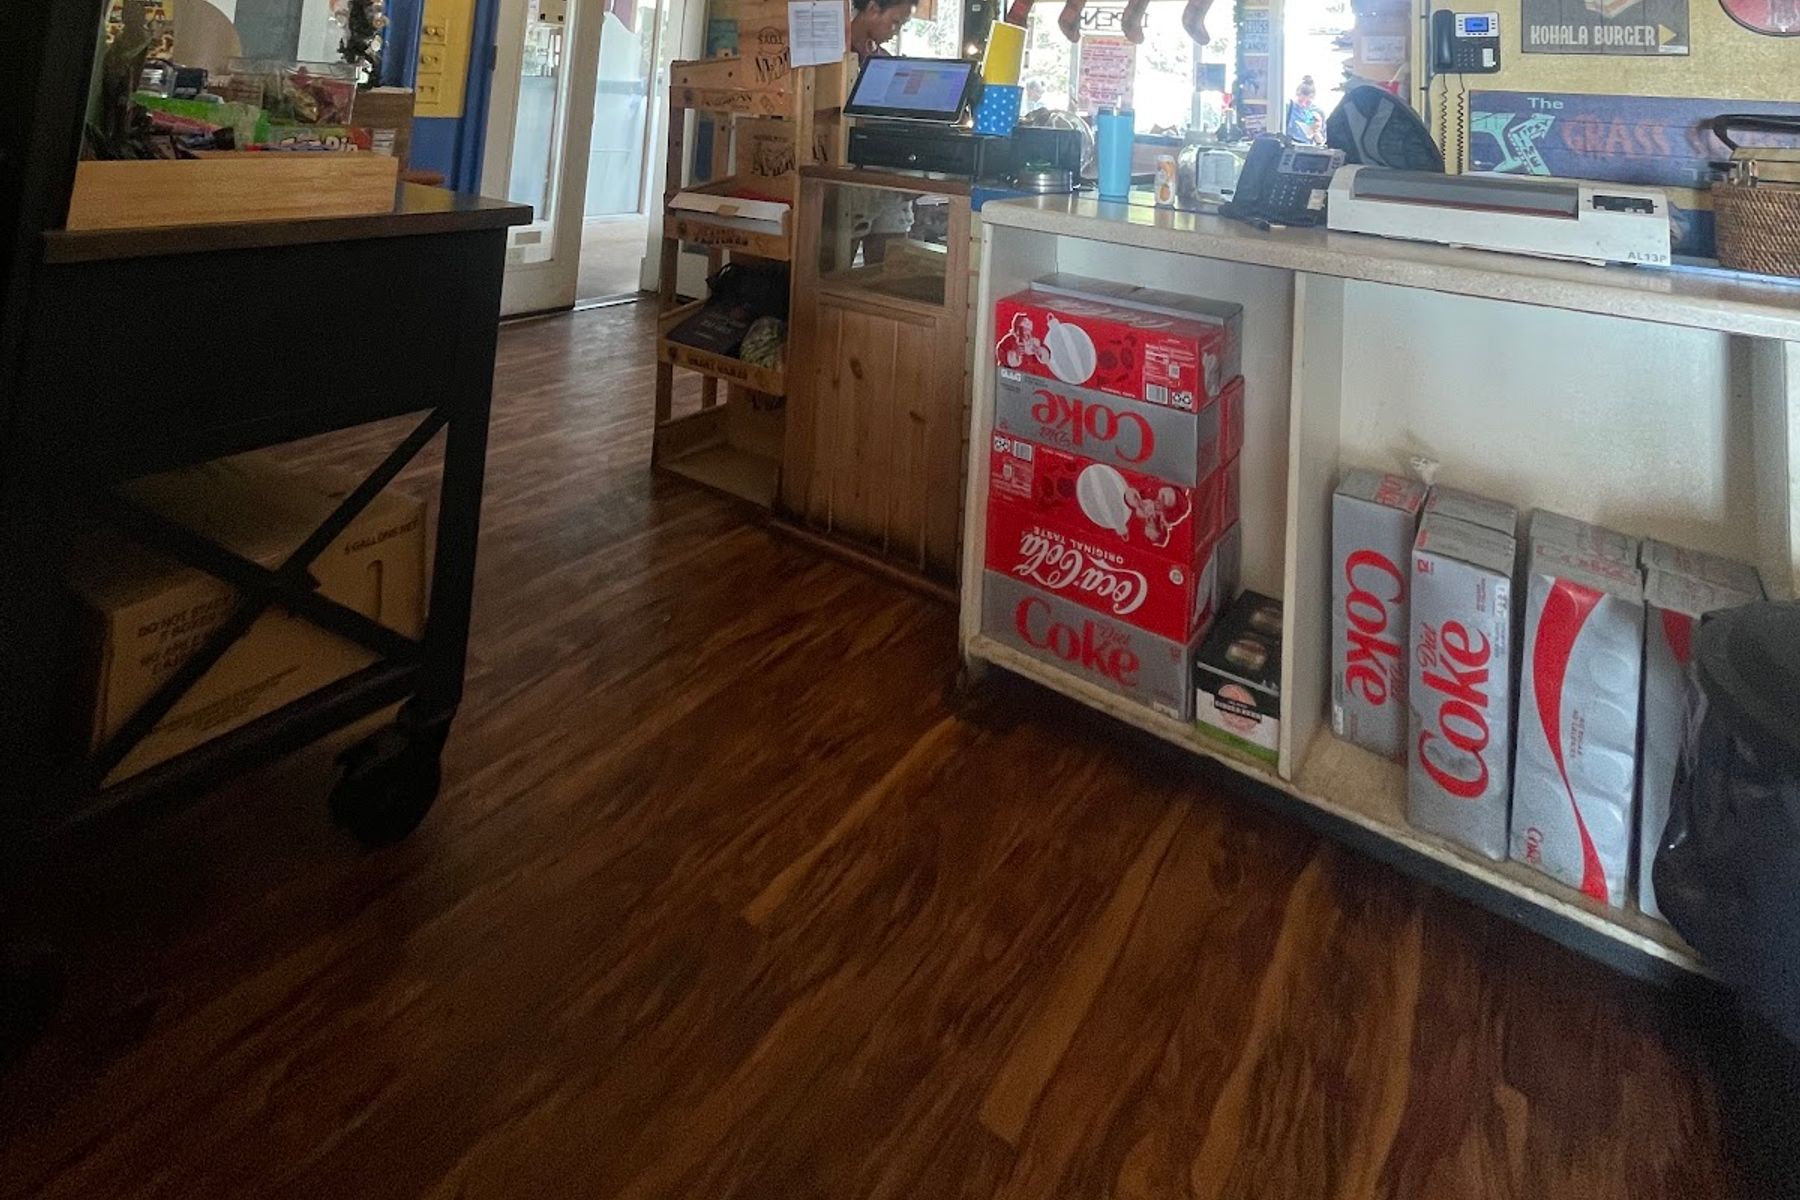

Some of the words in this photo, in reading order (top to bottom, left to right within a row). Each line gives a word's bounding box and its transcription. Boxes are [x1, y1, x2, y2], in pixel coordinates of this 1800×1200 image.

[1530, 25, 1589, 46] KOHALA
[1594, 25, 1657, 47] BURGER
[1527, 97, 1564, 110] The
[1562, 113, 1671, 159] GRASS
[1031, 388, 1155, 465] Coke
[1034, 525, 1066, 545] TASTE
[1071, 538, 1124, 565] ORIGINAL
[1012, 532, 1148, 615] Coca-Cola
[1015, 595, 1140, 688] Coke
[1345, 549, 1408, 706] Coke
[1418, 619, 1492, 798] Coke
